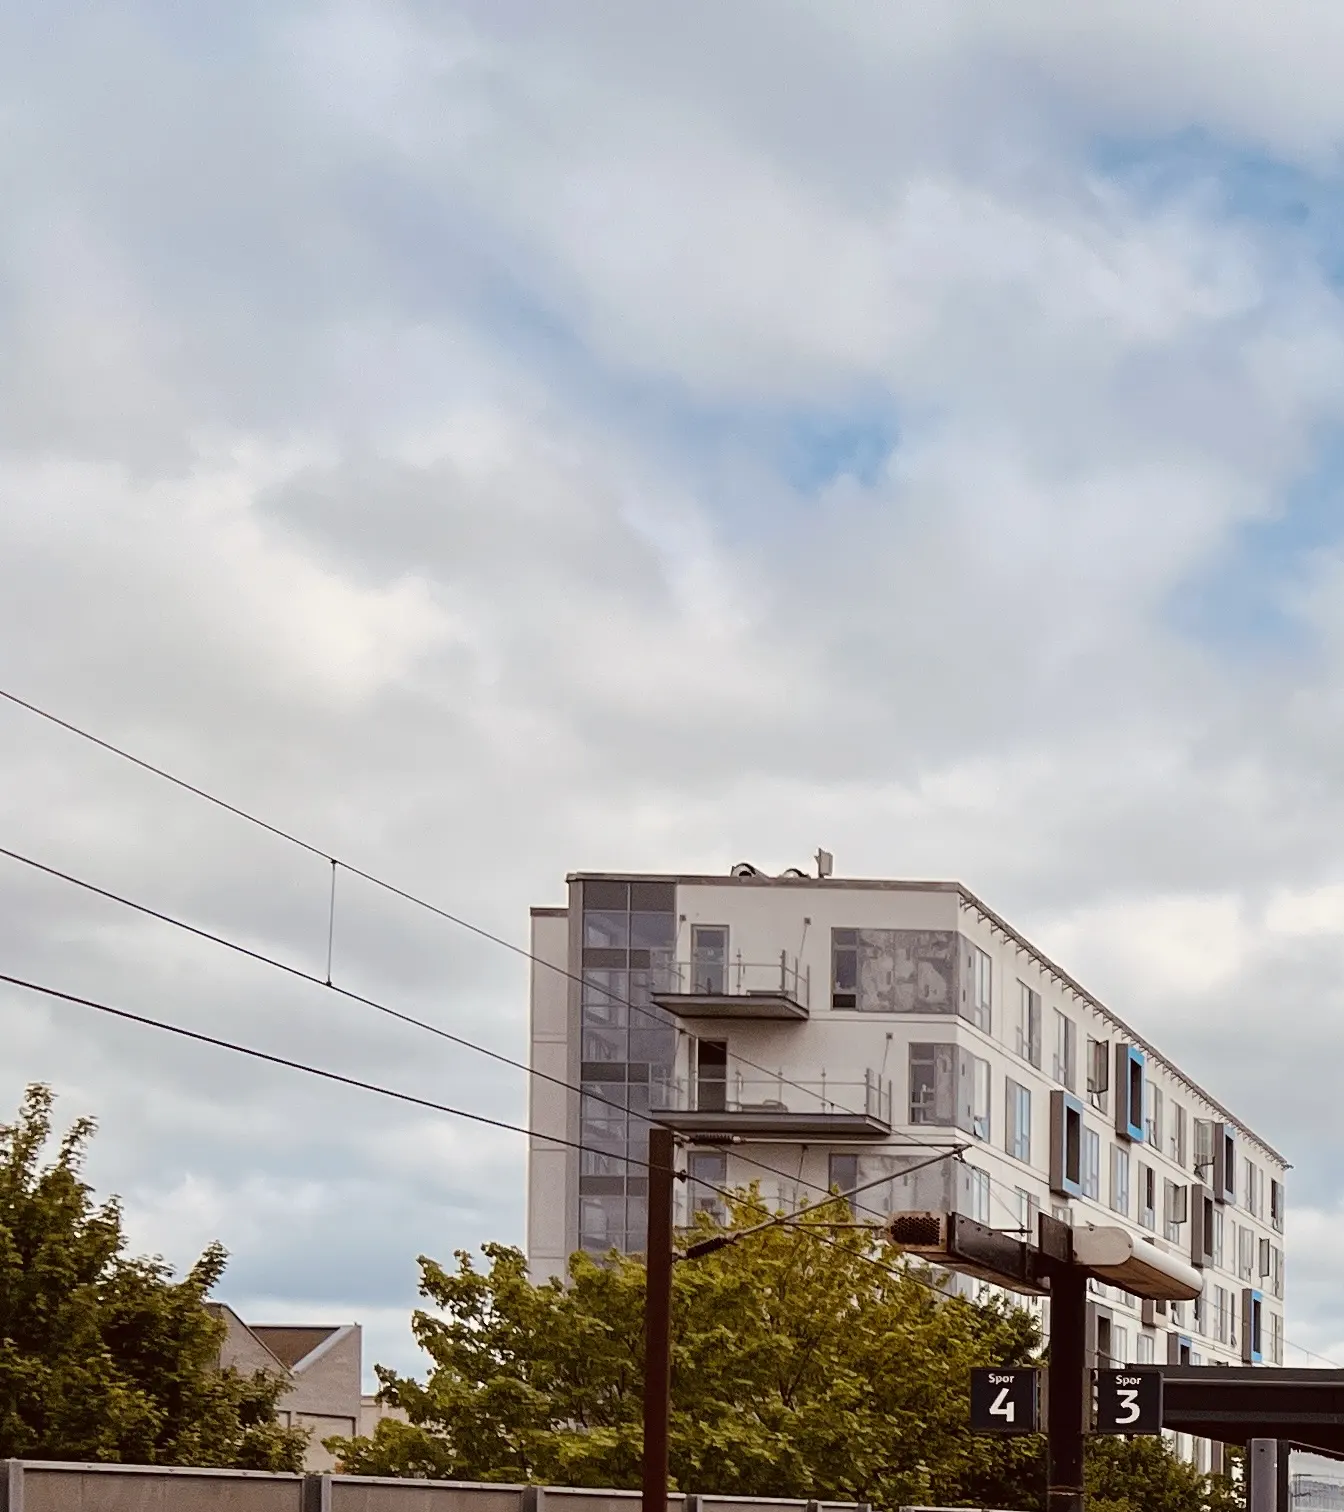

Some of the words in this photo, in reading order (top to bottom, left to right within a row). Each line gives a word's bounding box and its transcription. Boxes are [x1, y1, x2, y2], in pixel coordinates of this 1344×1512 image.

[988, 1373, 1015, 1384] Spor
[1115, 1375, 1142, 1386] Spor
[989, 1387, 1015, 1422] 4
[1115, 1389, 1141, 1424] 3
